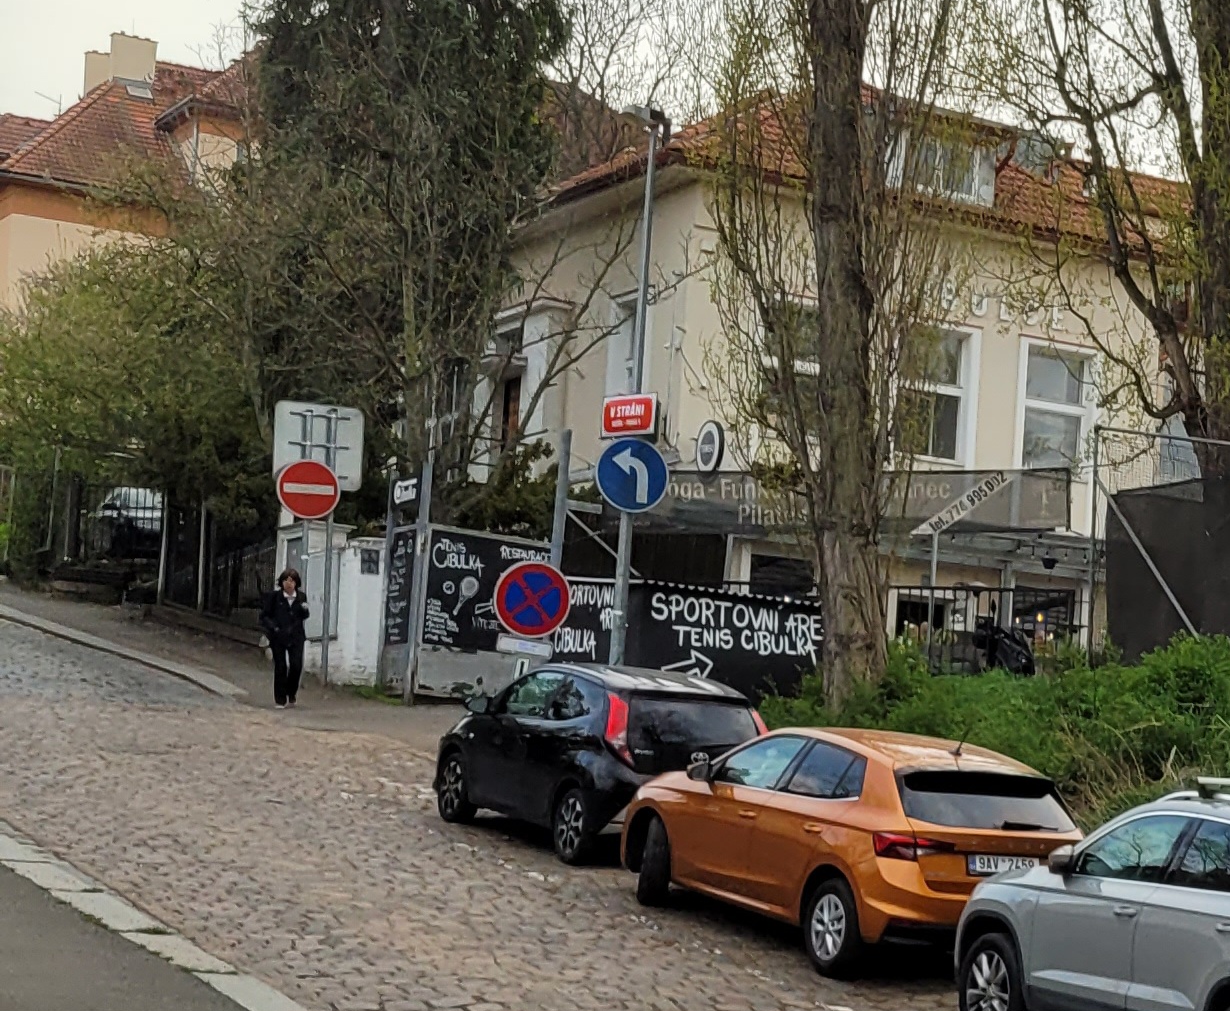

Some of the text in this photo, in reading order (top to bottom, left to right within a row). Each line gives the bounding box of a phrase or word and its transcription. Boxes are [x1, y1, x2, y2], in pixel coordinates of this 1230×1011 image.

[610, 402, 645, 418] V STRÁNI
[432, 542, 486, 579] CIBULKA
[651, 591, 825, 641] SPORTOVNÍ ARE
[554, 625, 597, 661] CIBULKA
[672, 624, 818, 666] TENIS CIBULKA
[978, 856, 1000, 870] 9AV
